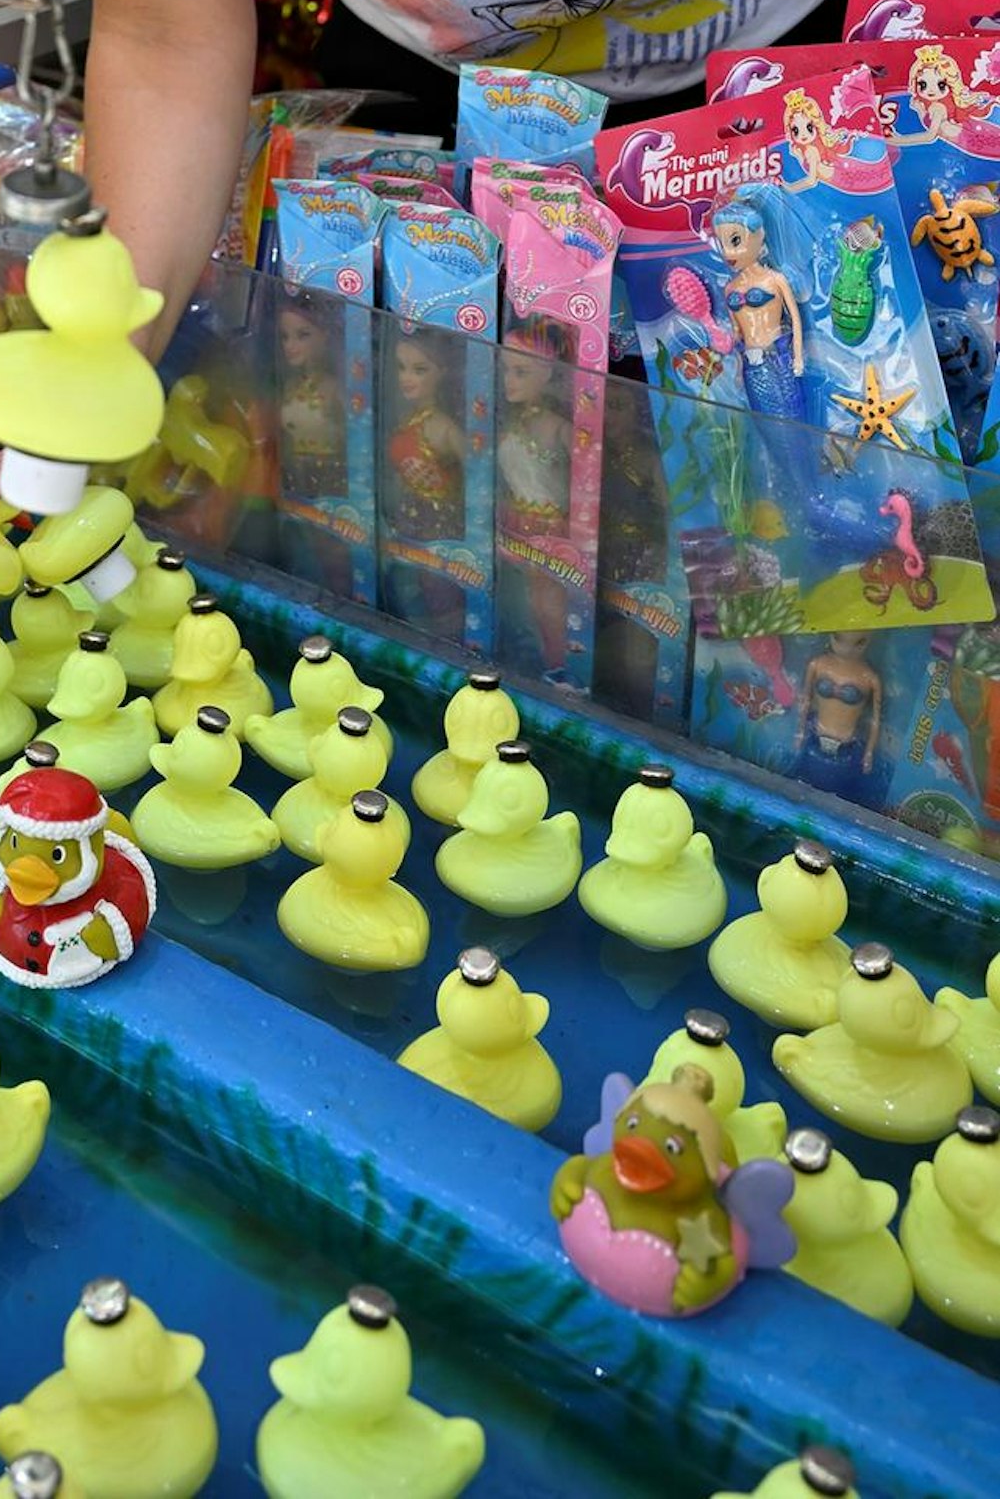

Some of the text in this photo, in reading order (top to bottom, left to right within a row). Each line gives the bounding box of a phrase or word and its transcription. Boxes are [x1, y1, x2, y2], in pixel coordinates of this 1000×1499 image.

[640, 146, 783, 205] Mermaids
[668, 144, 730, 173] The mini
